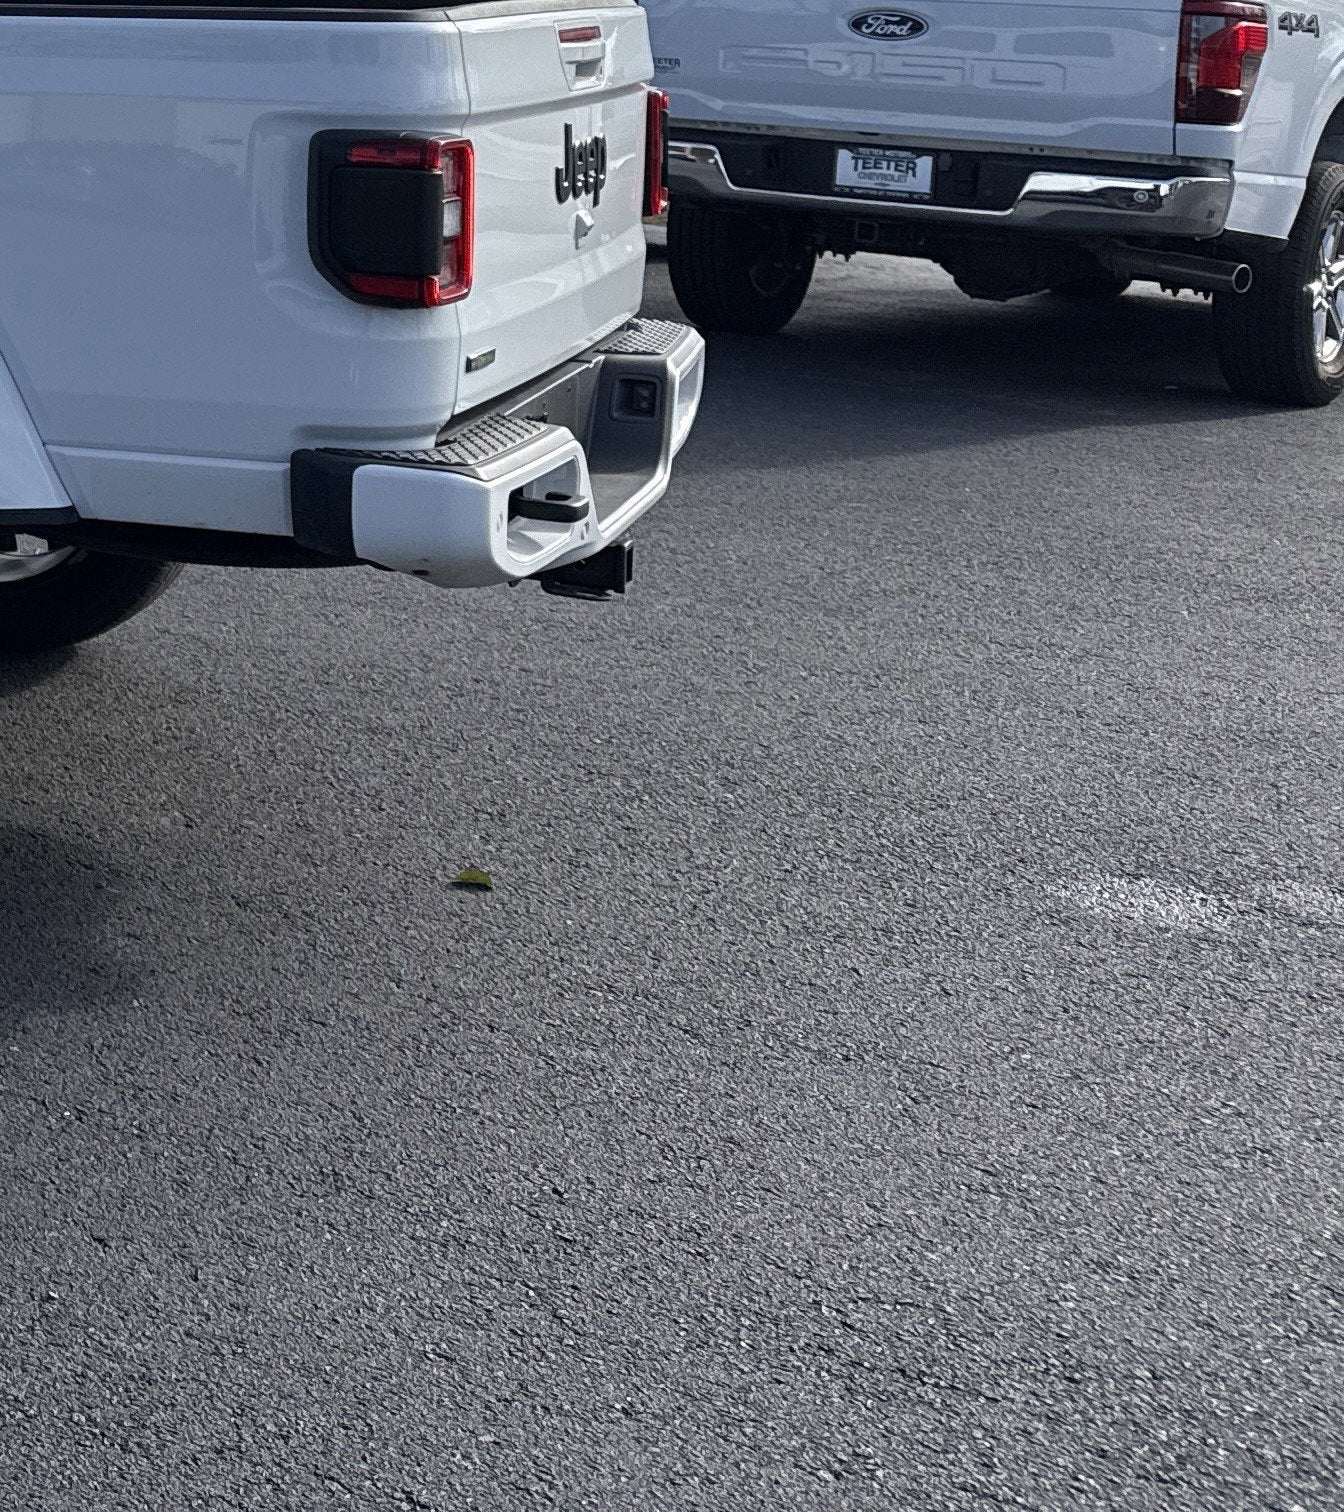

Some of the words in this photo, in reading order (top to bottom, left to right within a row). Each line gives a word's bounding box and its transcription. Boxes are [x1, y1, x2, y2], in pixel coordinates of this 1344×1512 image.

[861, 15, 912, 36] Ford
[555, 123, 607, 208] Jeep
[852, 156, 916, 178] TEETER
